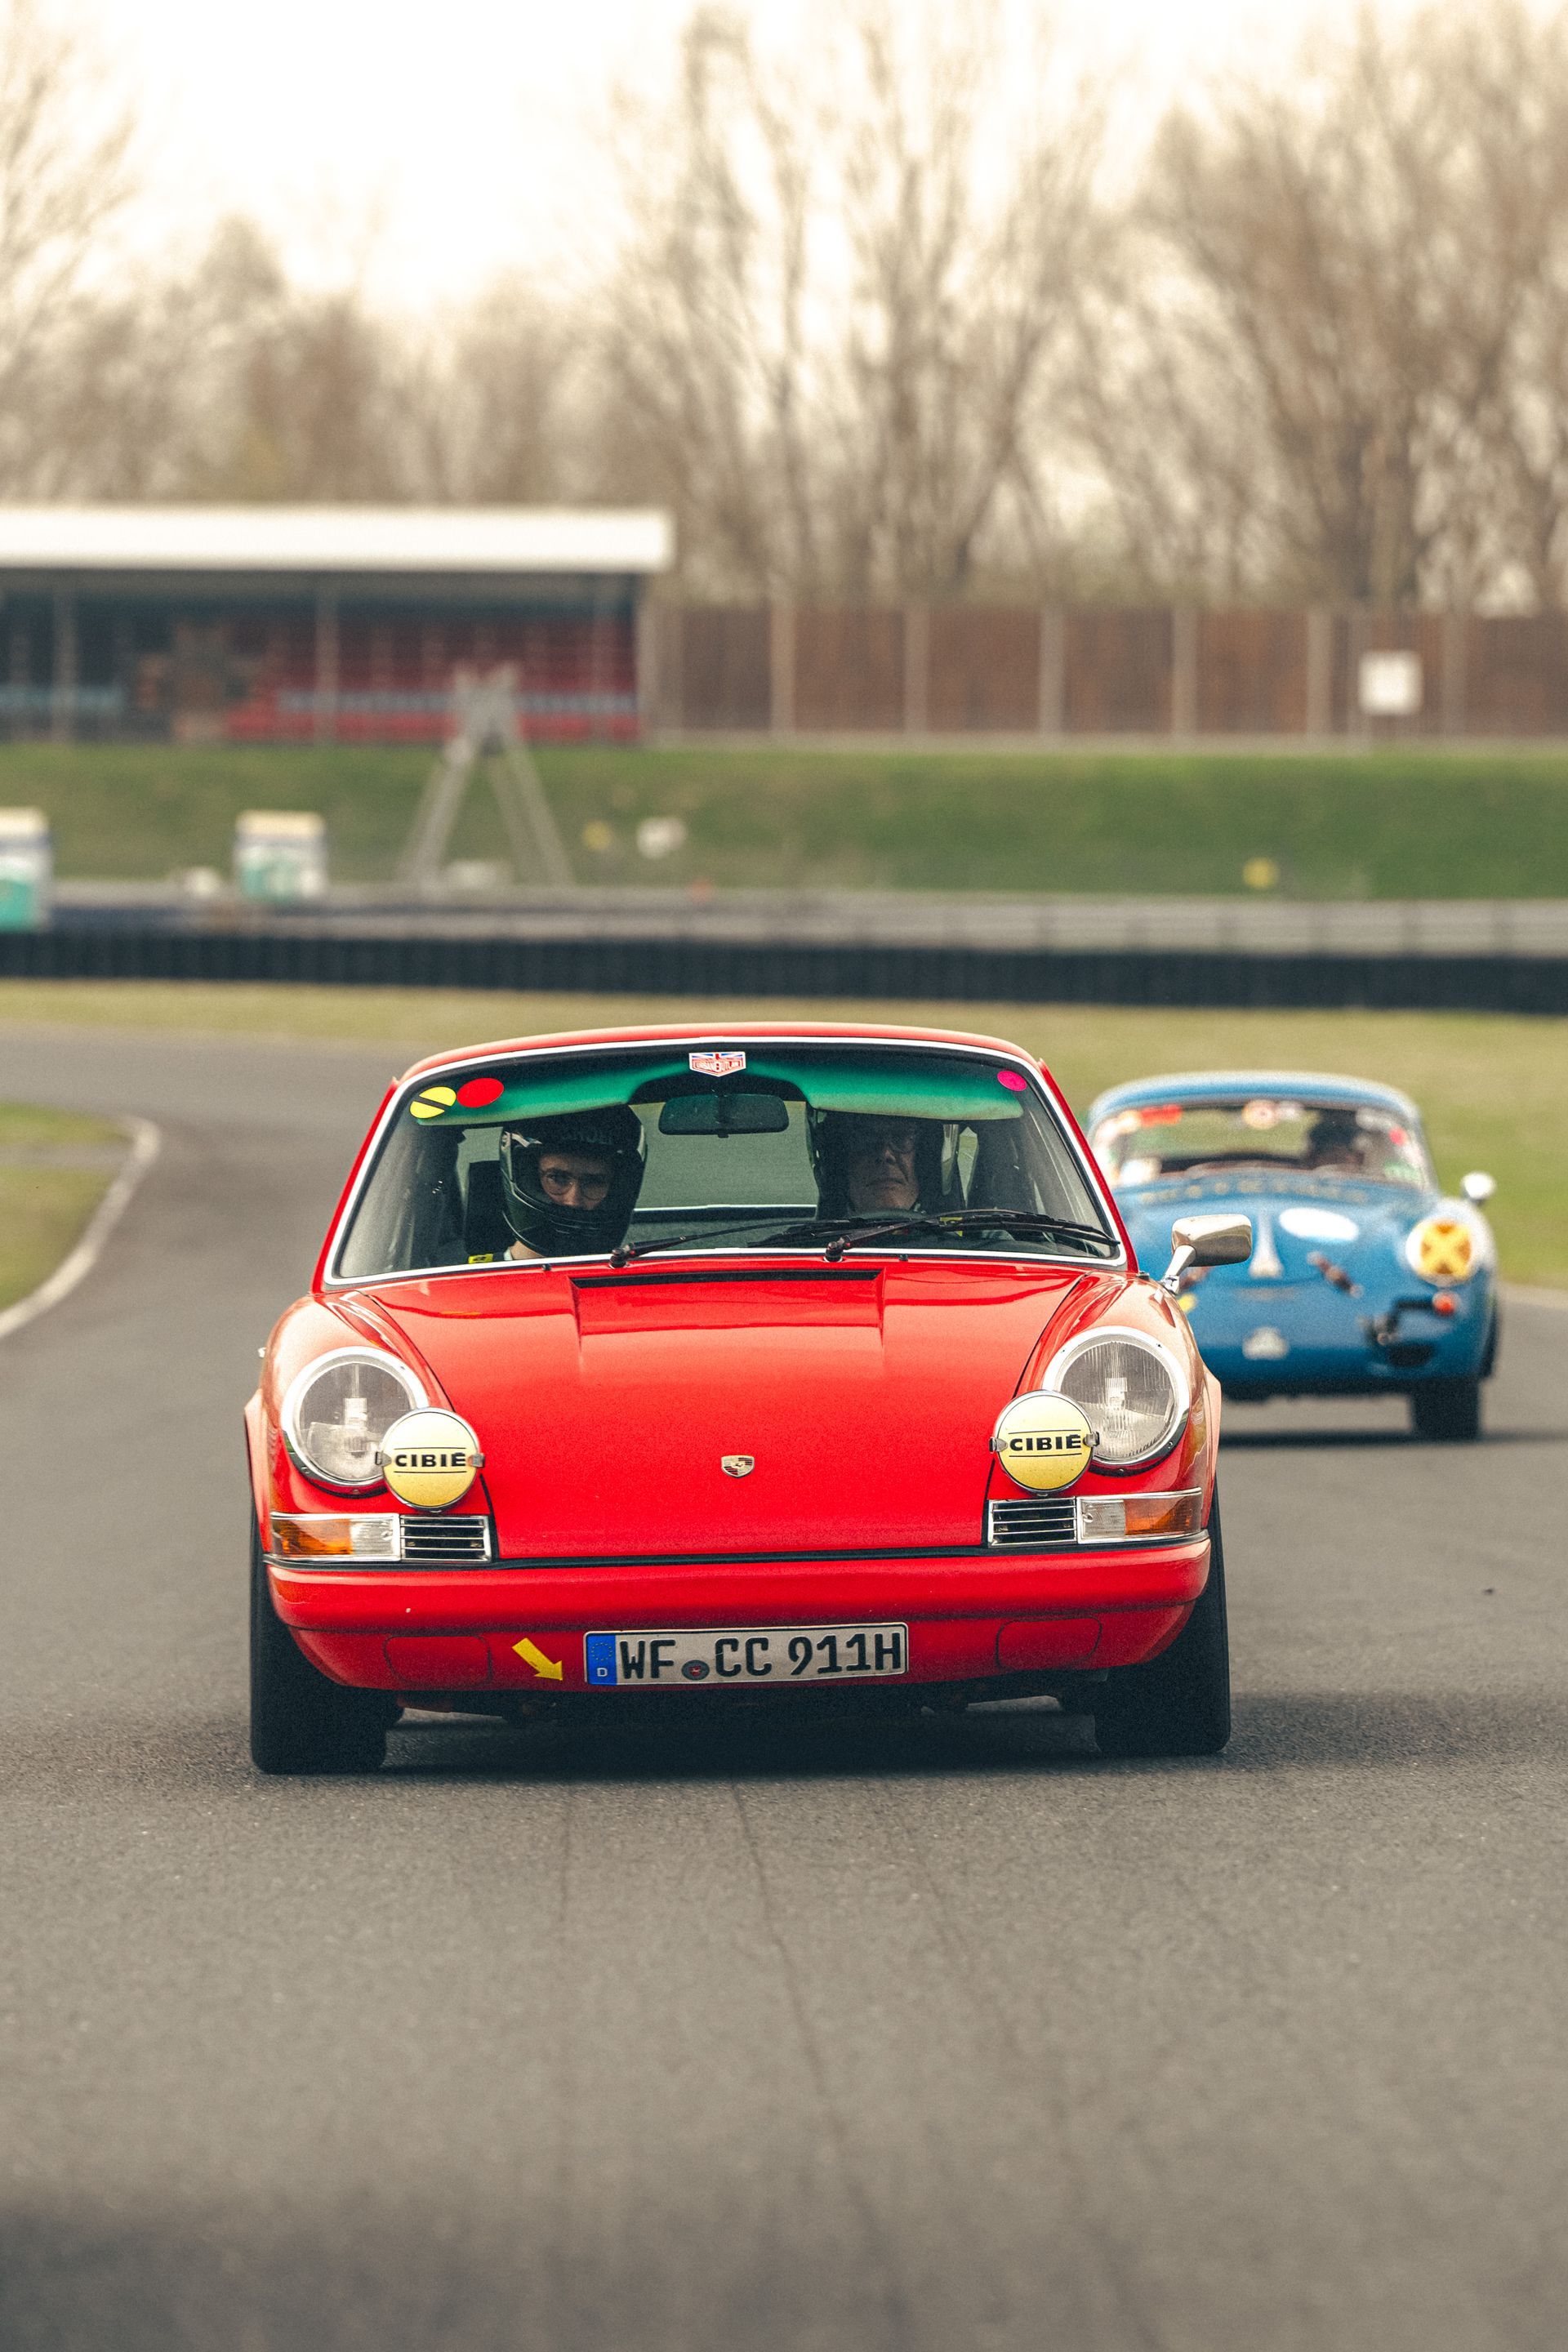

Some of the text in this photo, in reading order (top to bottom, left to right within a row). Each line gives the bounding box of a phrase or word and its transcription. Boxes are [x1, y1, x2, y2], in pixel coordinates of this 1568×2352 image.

[619, 1633, 902, 1679] WF CC 911H
[597, 1667, 608, 1677] D
